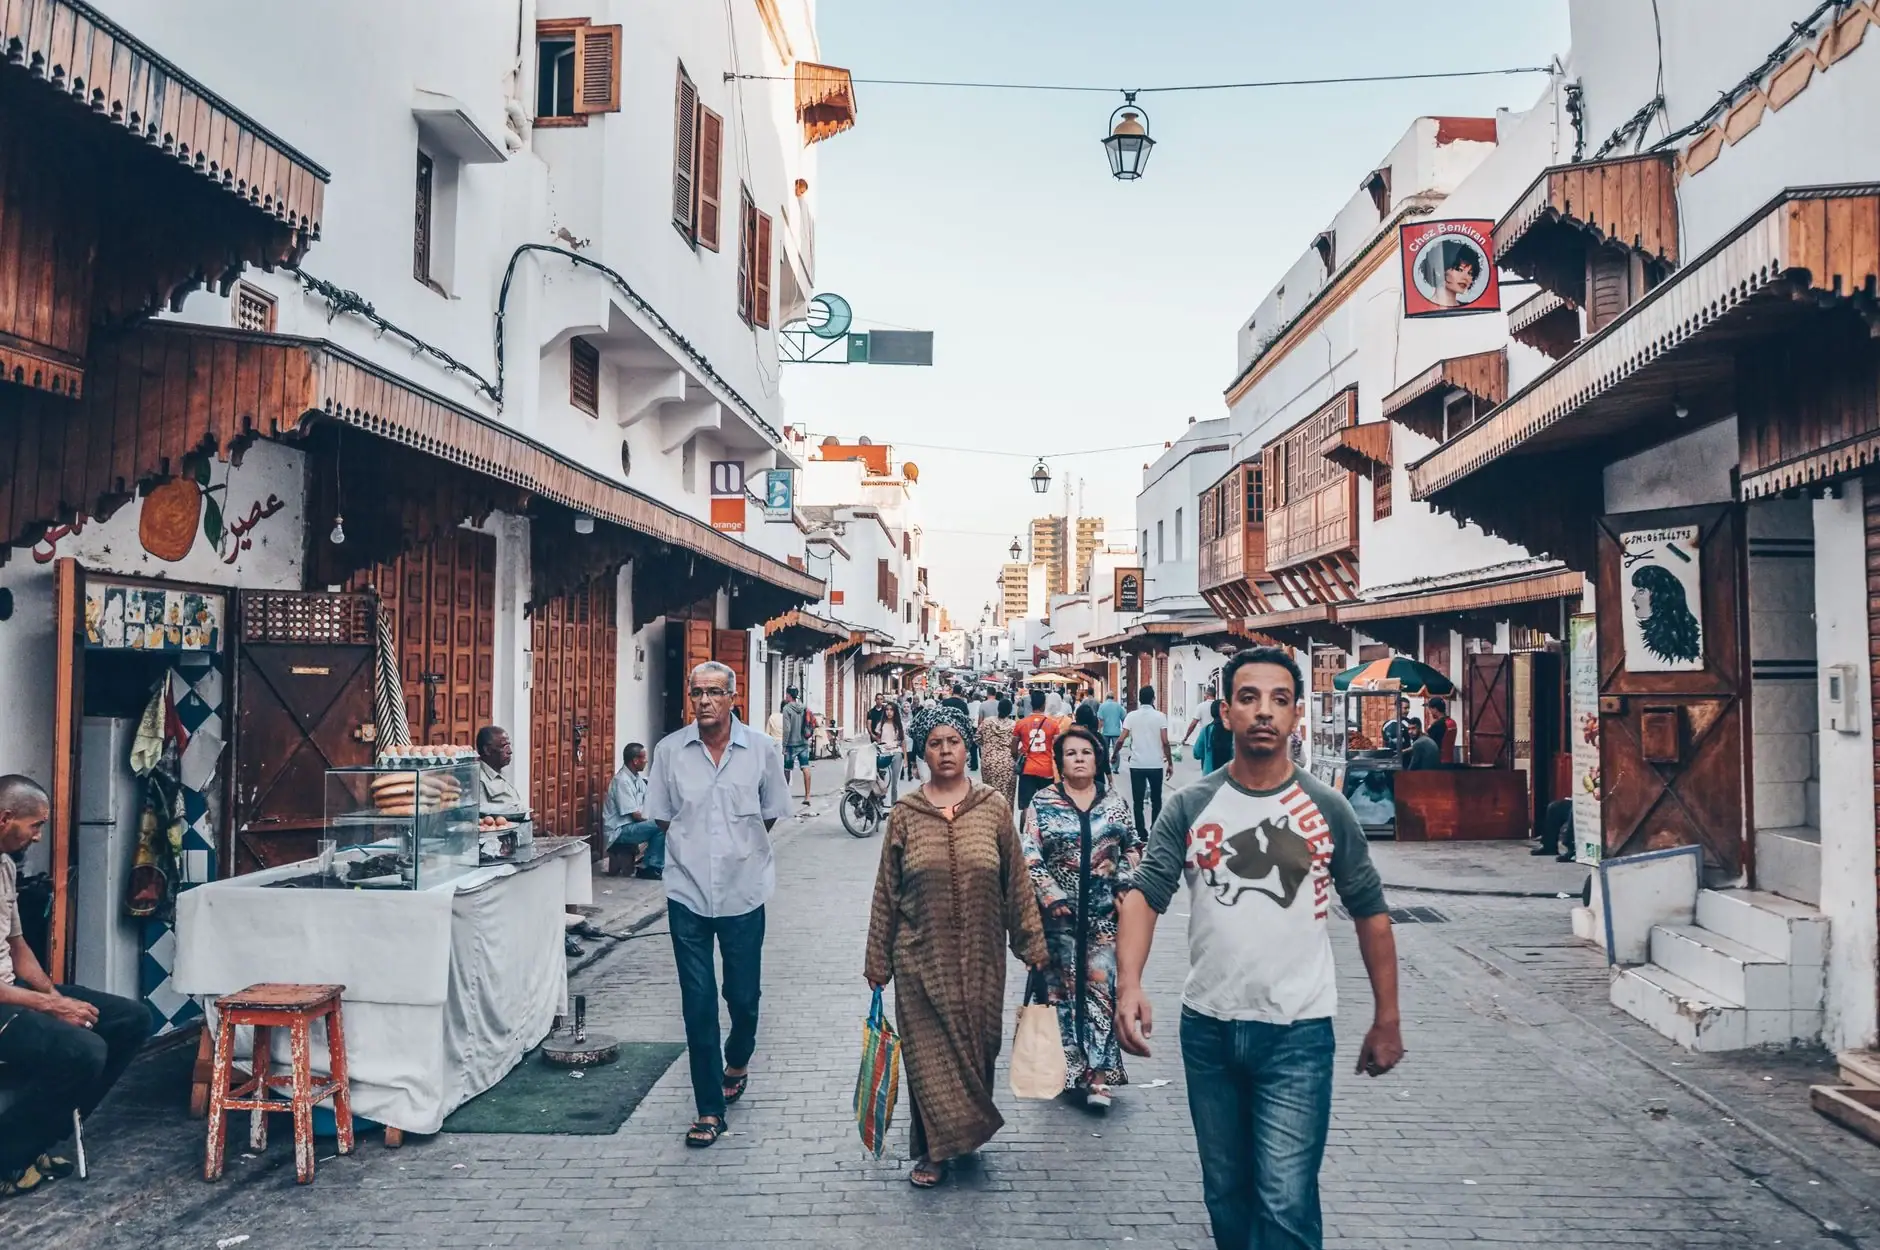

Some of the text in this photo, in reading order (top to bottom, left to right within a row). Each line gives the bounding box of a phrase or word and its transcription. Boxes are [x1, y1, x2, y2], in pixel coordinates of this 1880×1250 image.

[1409, 223, 1487, 252] Chez Benkiran
[224, 493, 285, 564] عصير
[712, 521, 742, 529] orange
[1029, 728, 1047, 752] 2
